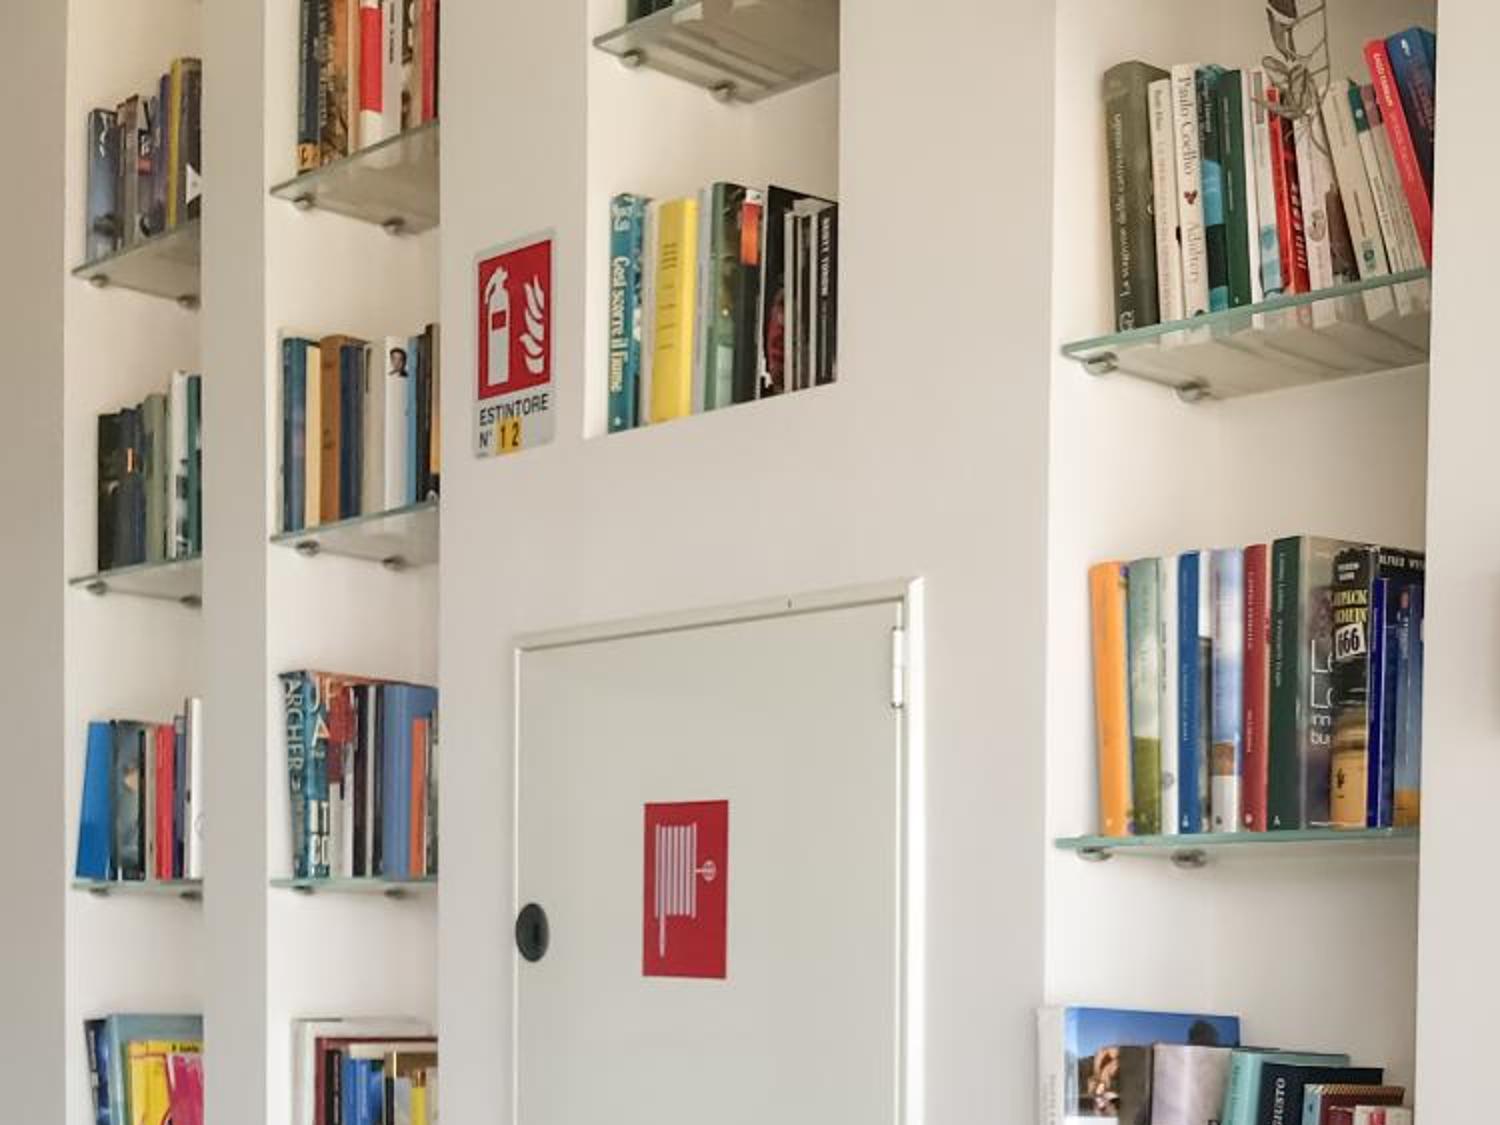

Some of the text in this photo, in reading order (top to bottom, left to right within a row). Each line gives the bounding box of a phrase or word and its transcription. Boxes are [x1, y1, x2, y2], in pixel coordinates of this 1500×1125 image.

[1182, 121, 1197, 176] Coelho
[479, 393, 549, 427] ESTINTORE
[286, 678, 306, 770] ARCHER
